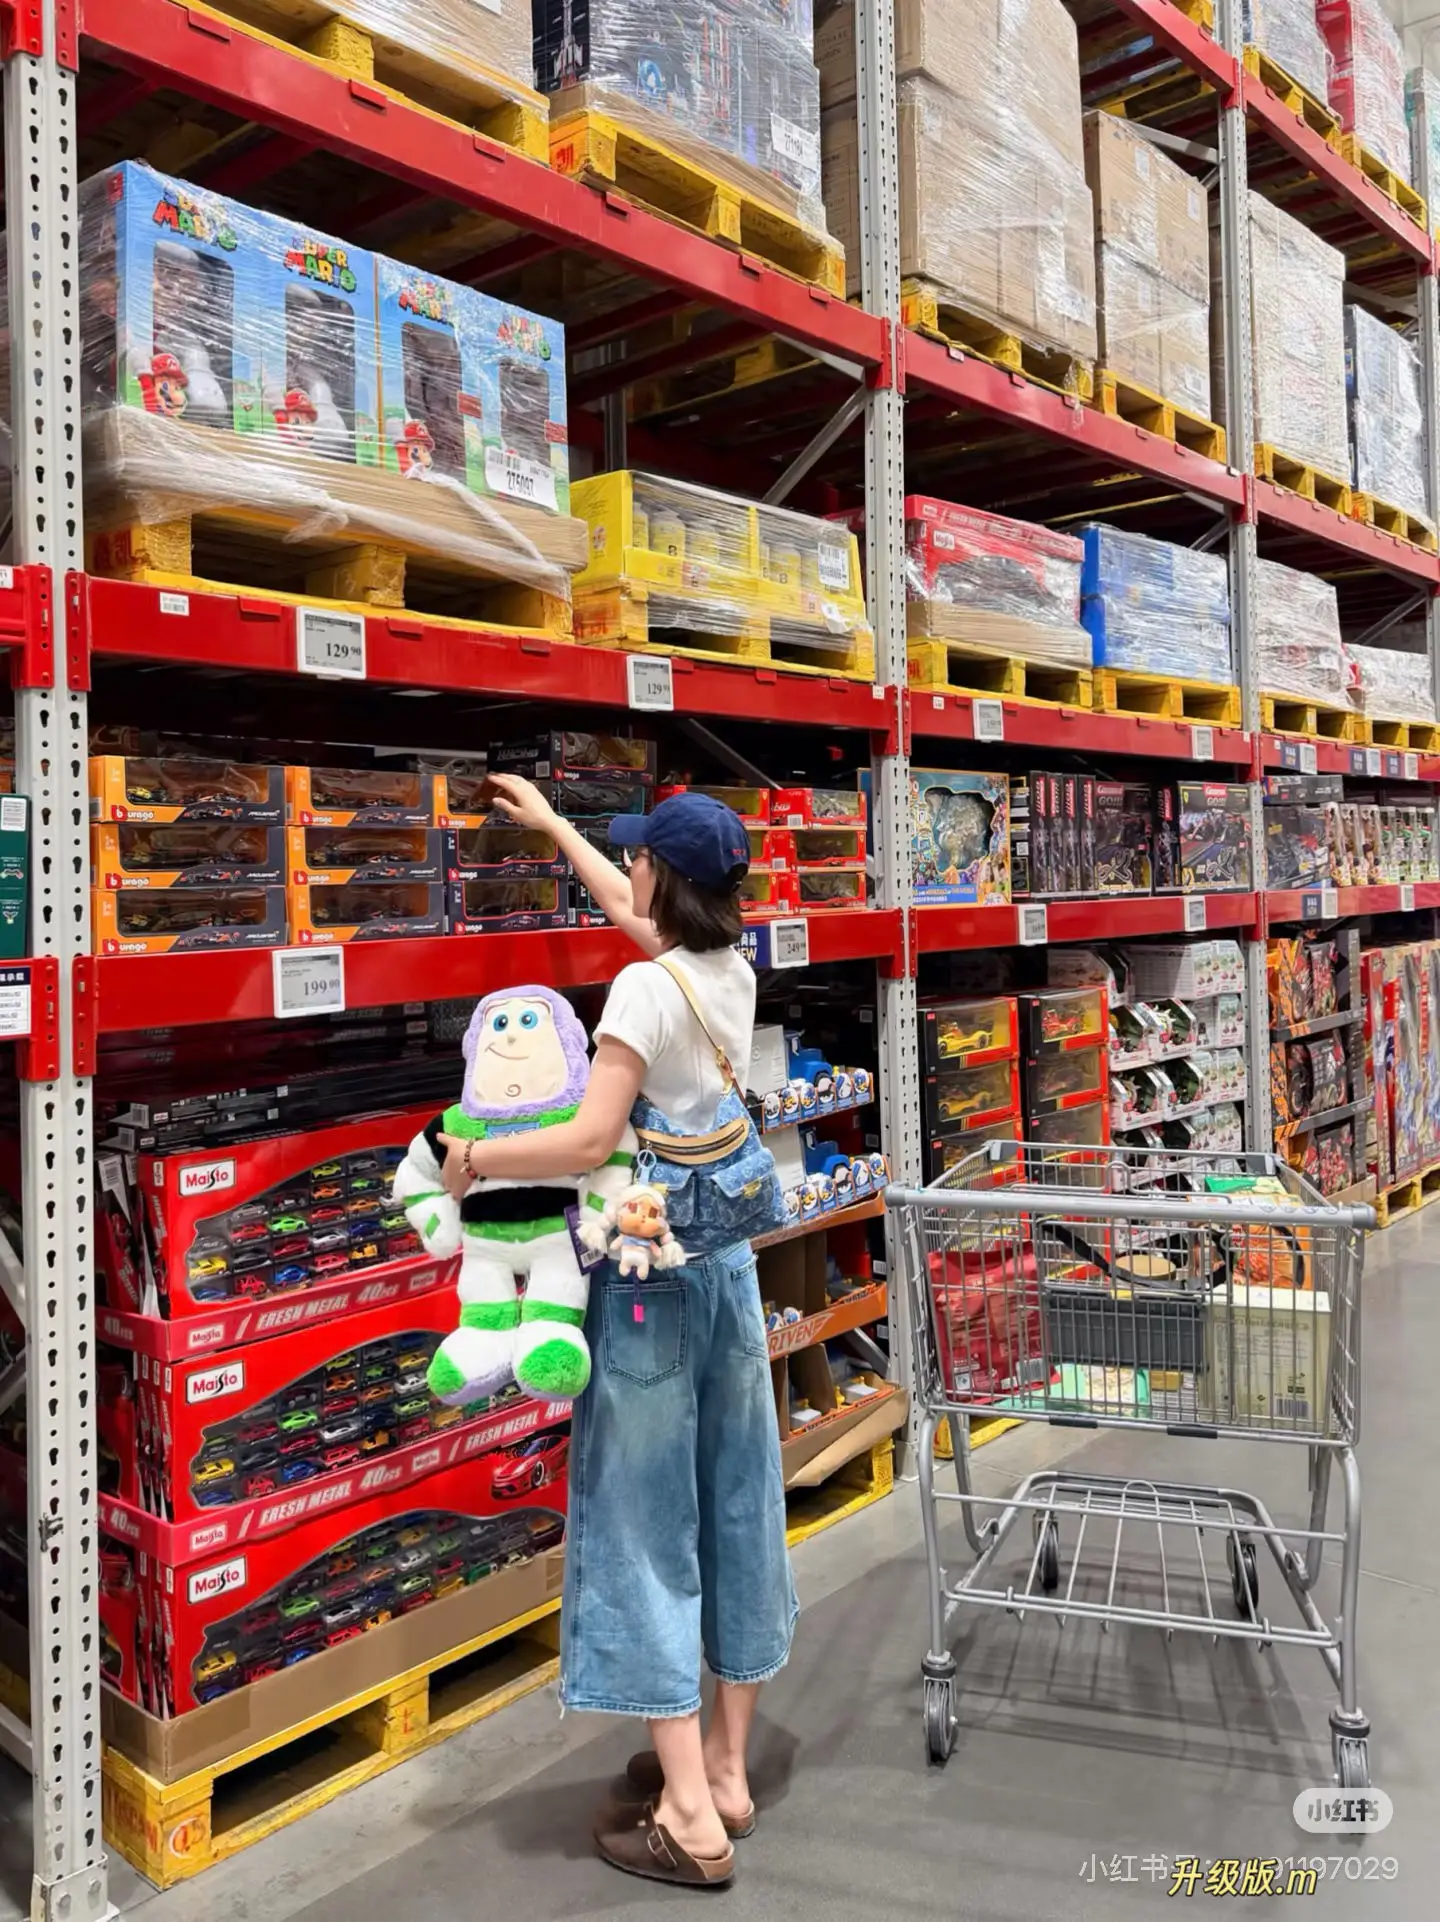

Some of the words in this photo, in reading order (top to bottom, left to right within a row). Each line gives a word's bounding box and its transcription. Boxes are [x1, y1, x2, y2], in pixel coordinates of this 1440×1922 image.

[283, 249, 357, 293] MARIO
[185, 1166, 229, 1190] Maisto
[190, 1328, 222, 1346] Maisto
[256, 1305, 302, 1332] FRESH
[303, 1294, 351, 1318] METAL
[193, 1370, 238, 1396] Maisto
[466, 1426, 504, 1452] FRESH
[502, 1410, 538, 1436] METAL
[194, 1528, 224, 1546] Maisto
[259, 1500, 305, 1527] FRESH
[305, 1481, 353, 1512] METAL
[195, 1566, 240, 1594] Maisto
